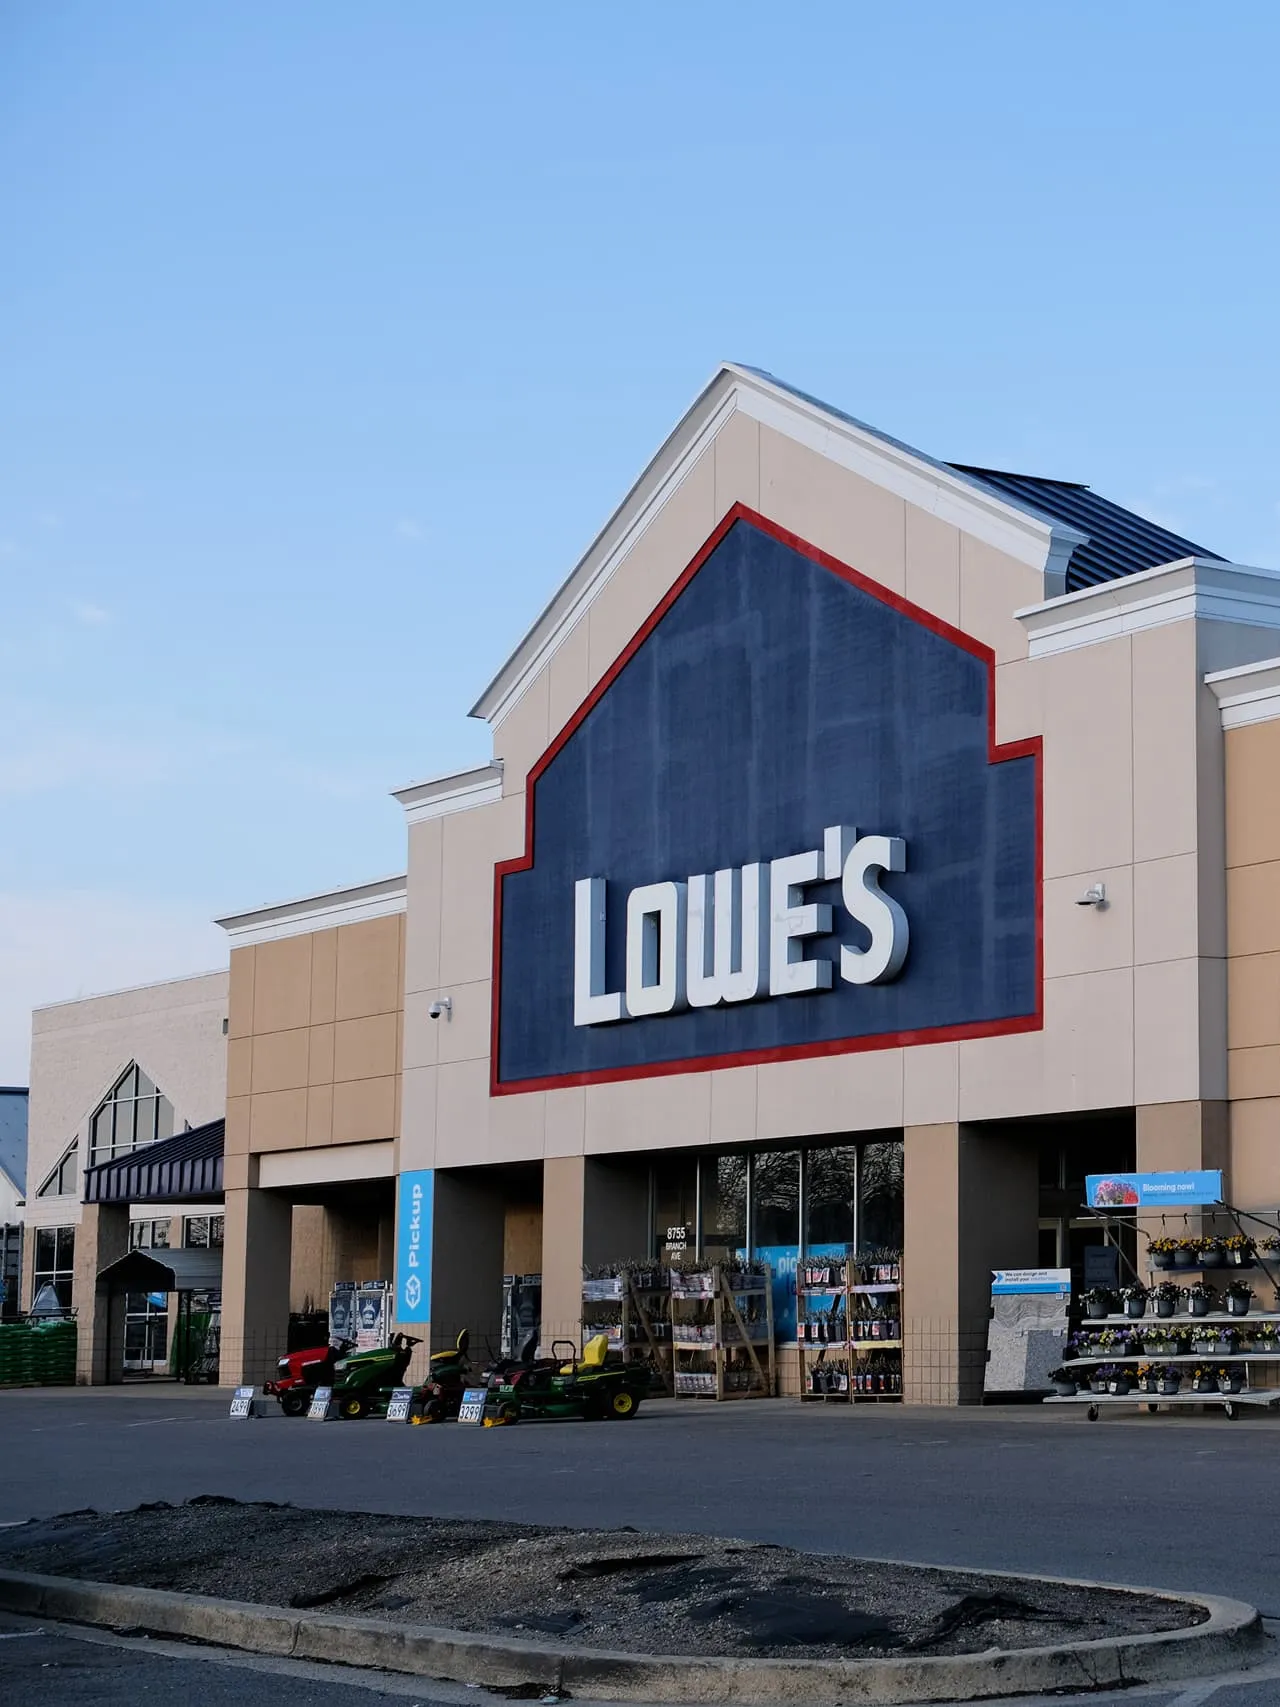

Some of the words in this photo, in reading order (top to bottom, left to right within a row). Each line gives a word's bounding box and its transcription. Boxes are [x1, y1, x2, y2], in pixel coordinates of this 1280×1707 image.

[574, 826, 910, 1026] LOWE'S
[1143, 1183, 1176, 1193] Blooming
[1177, 1182, 1195, 1191] now!
[408, 1183, 424, 1268] Pickup
[667, 1227, 686, 1240] 8755
[671, 1252, 681, 1261] AVE
[388, 1403, 407, 1417] 3699
[460, 1404, 480, 1420] 3299
